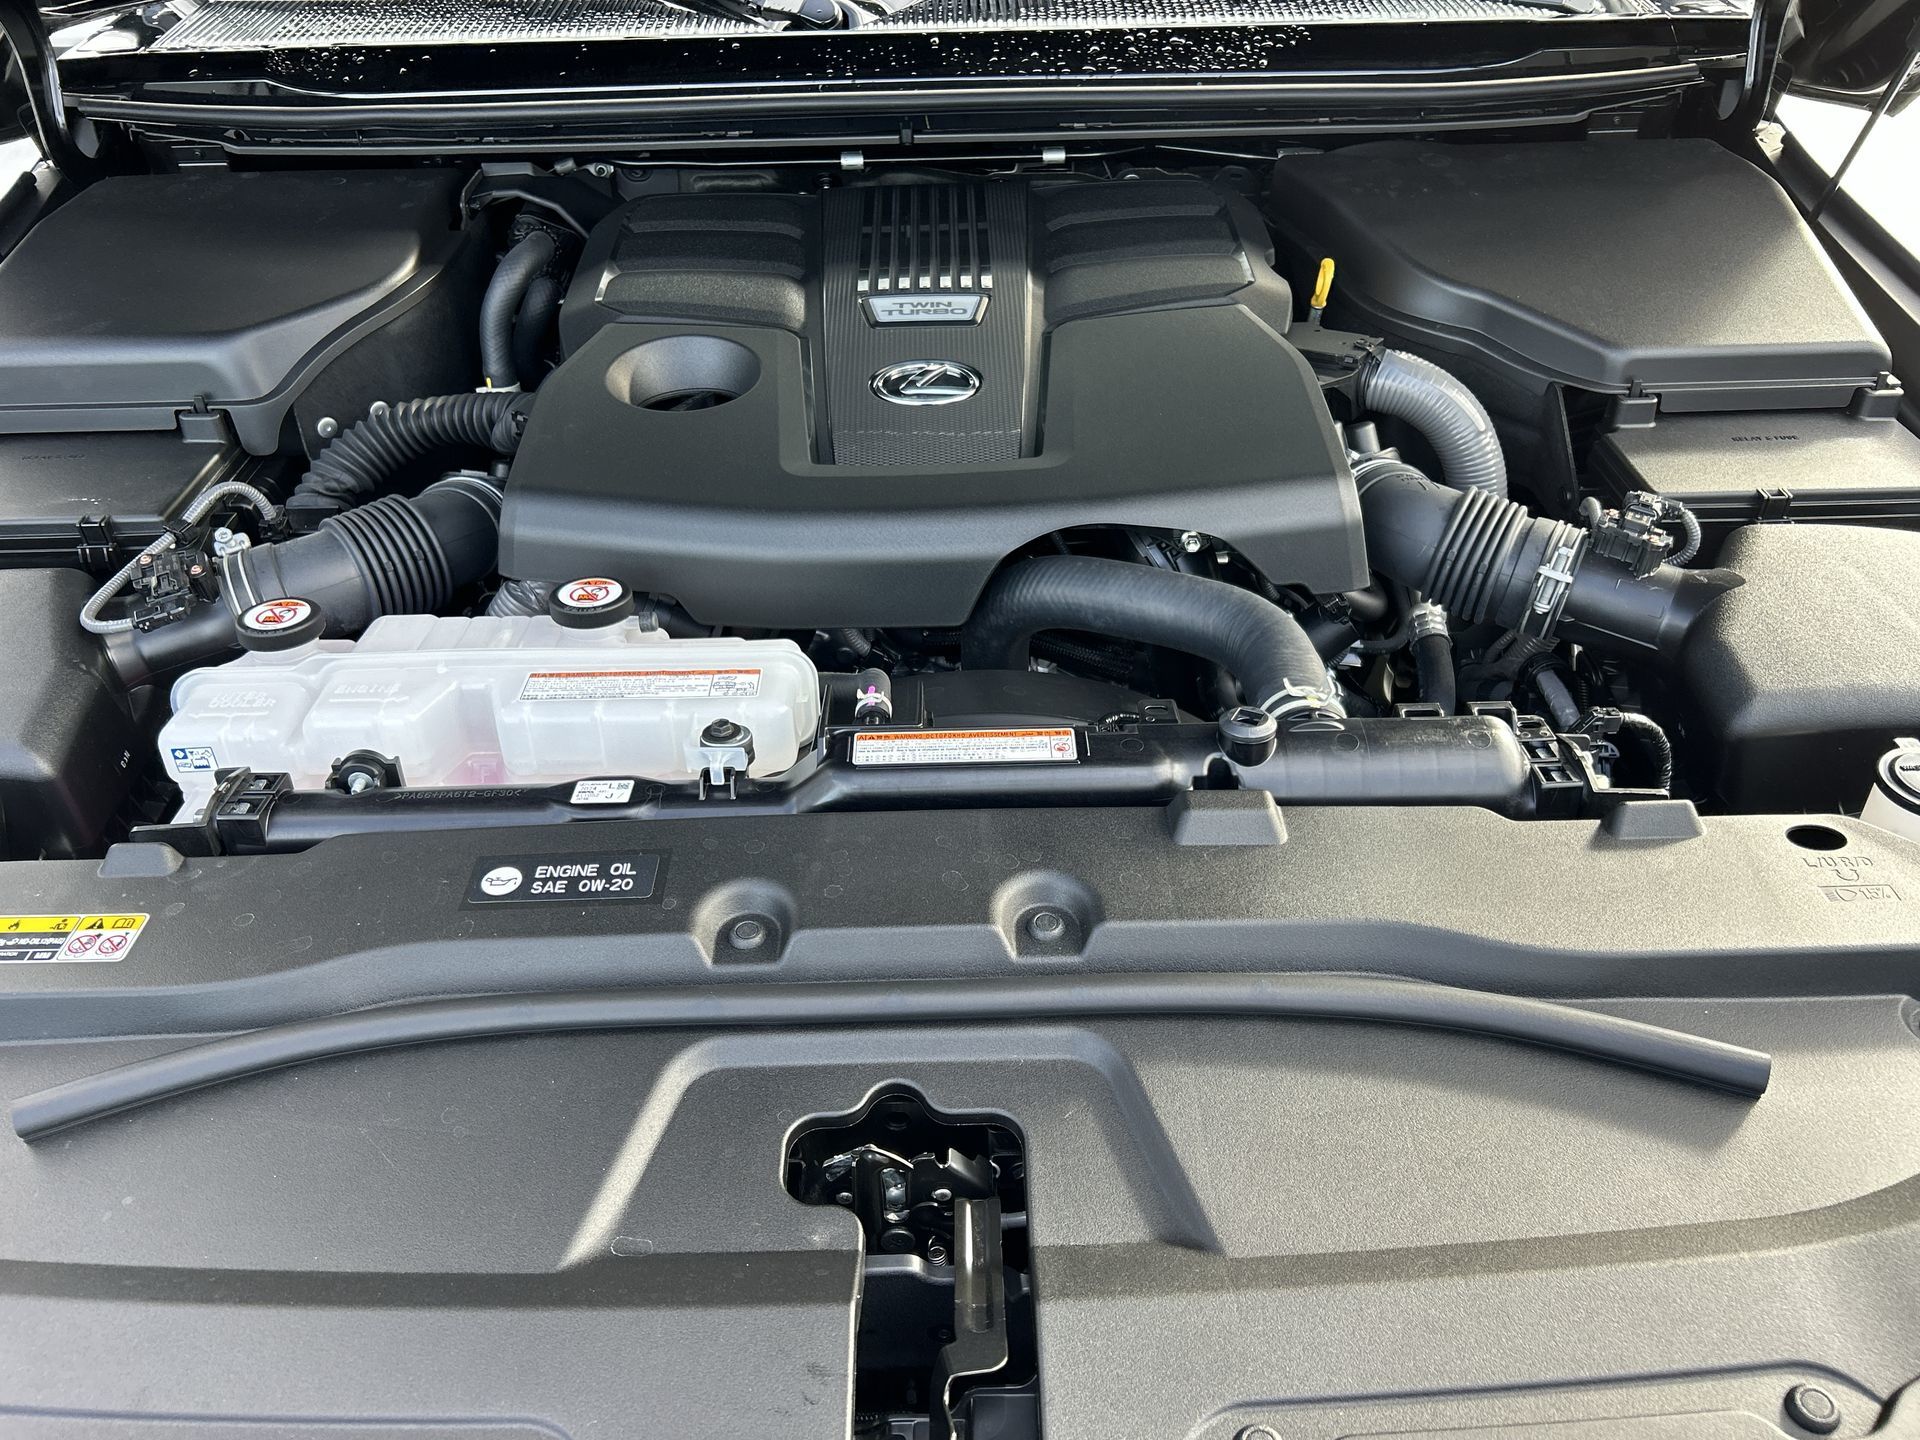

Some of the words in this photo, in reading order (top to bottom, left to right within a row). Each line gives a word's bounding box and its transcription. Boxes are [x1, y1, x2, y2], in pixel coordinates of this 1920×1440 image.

[881, 308, 967, 316] TURBO
[893, 732, 923, 741] WARNING
[968, 730, 1018, 739] AVERTISSEMENT
[534, 864, 600, 878] ENGINE
[610, 863, 637, 876] OIL
[530, 880, 568, 894] SAE
[578, 878, 634, 892] 0W-20
